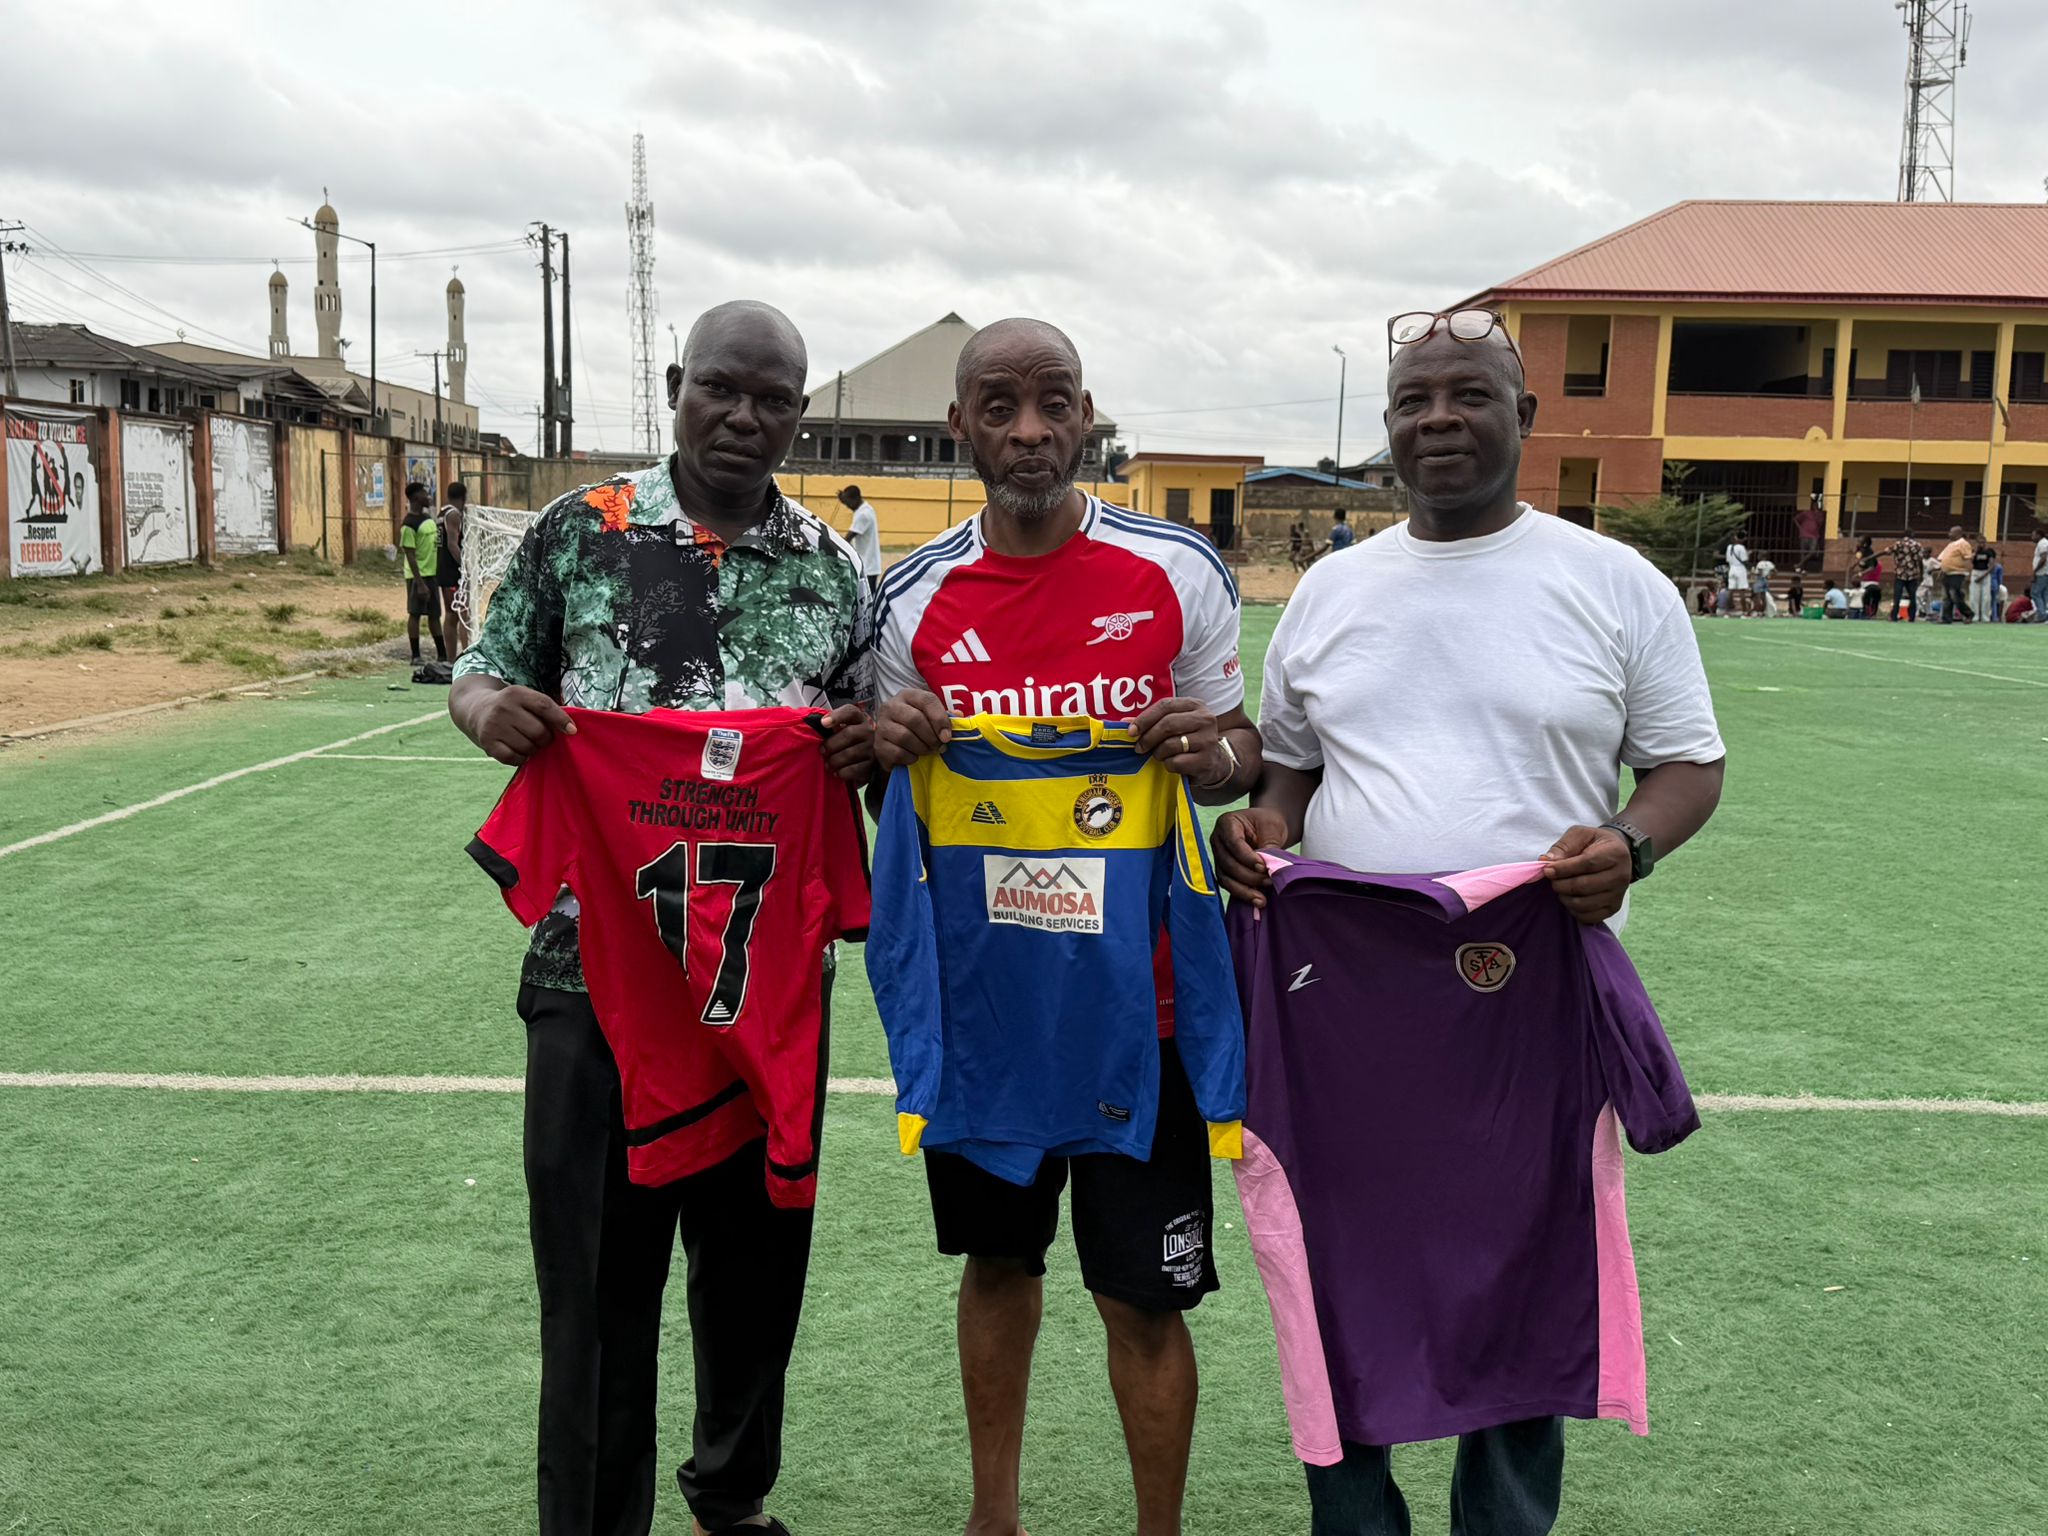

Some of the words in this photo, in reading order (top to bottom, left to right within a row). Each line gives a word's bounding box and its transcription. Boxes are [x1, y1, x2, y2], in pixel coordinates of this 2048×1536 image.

[38, 421, 47, 440] TO
[49, 422, 87, 443] VIOLENCE
[21, 543, 63, 563] REFEREES
[941, 672, 1154, 717] Emirates
[659, 778, 759, 808] STRENGTH
[628, 800, 721, 830] THROUGH
[726, 809, 780, 833] UNITY
[993, 887, 1097, 915] AUMOSA
[635, 841, 777, 1026] 17
[993, 910, 1043, 926] BUILDING
[1046, 917, 1099, 930] SERVICES
